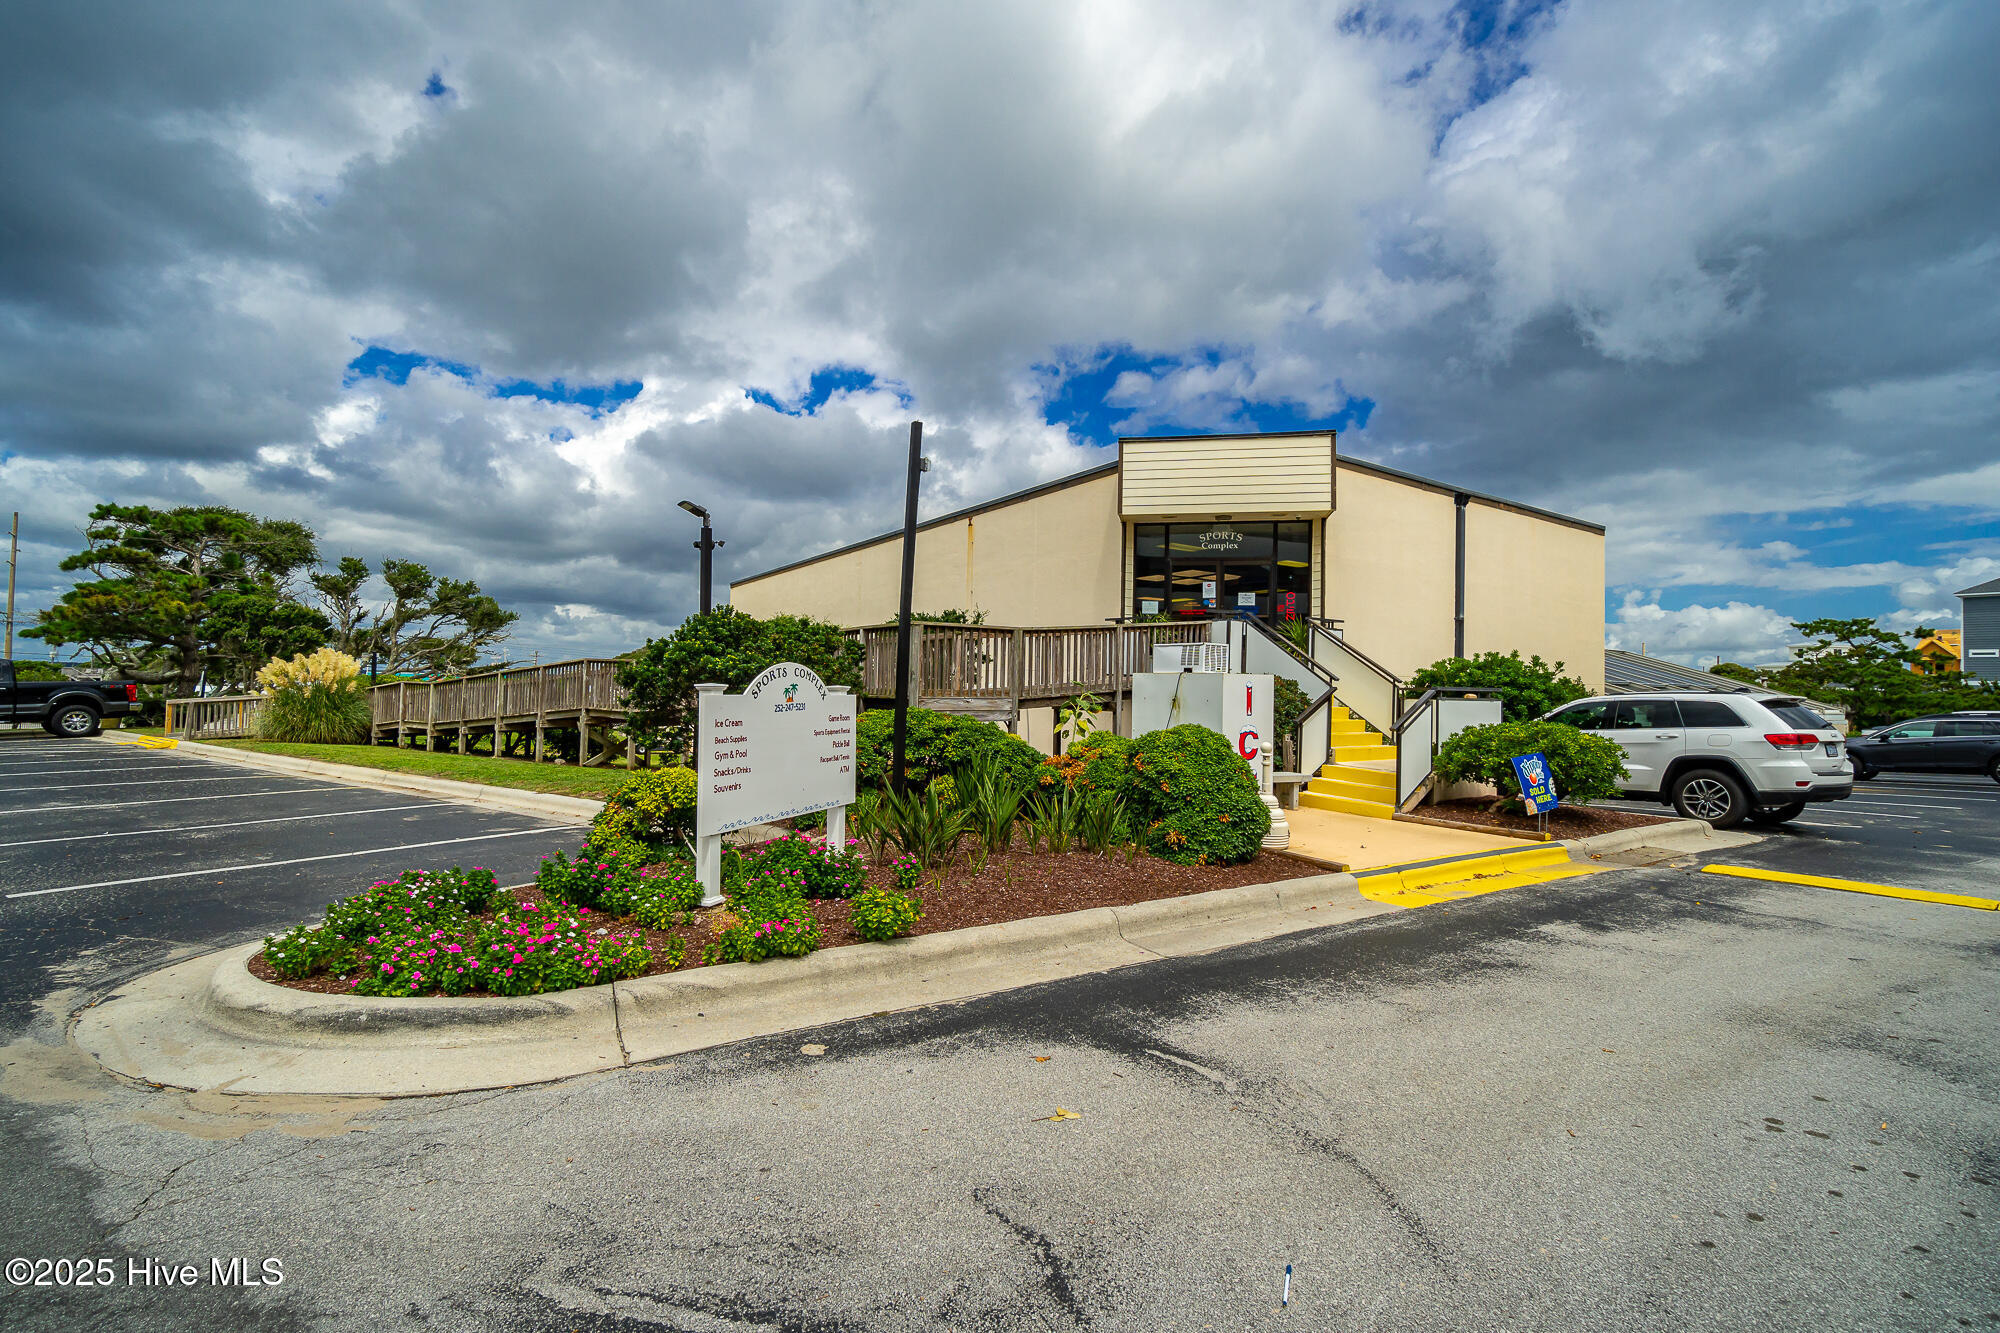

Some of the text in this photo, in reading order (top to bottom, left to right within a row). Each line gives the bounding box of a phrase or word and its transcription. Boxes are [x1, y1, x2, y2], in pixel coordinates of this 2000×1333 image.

[1199, 531, 1244, 543] SPORTS
[1201, 541, 1239, 551] Complex
[751, 667, 827, 701] SPORTS COMPLEX
[774, 702, 806, 713] 252-247-5231
[714, 718, 743, 728] Ice Cream
[828, 714, 839, 722] Game
[1239, 681, 1259, 780] IC
[714, 735, 747, 745] Beach Supplies
[832, 740, 843, 748] Pickle
[714, 748, 748, 762] Gym & Pool
[713, 766, 752, 777] Snacks/Drinks
[839, 765, 850, 774] ATM
[713, 782, 742, 794] Souvenirs
[1529, 786, 1545, 796] SOLD
[1536, 794, 1553, 804] HERE
